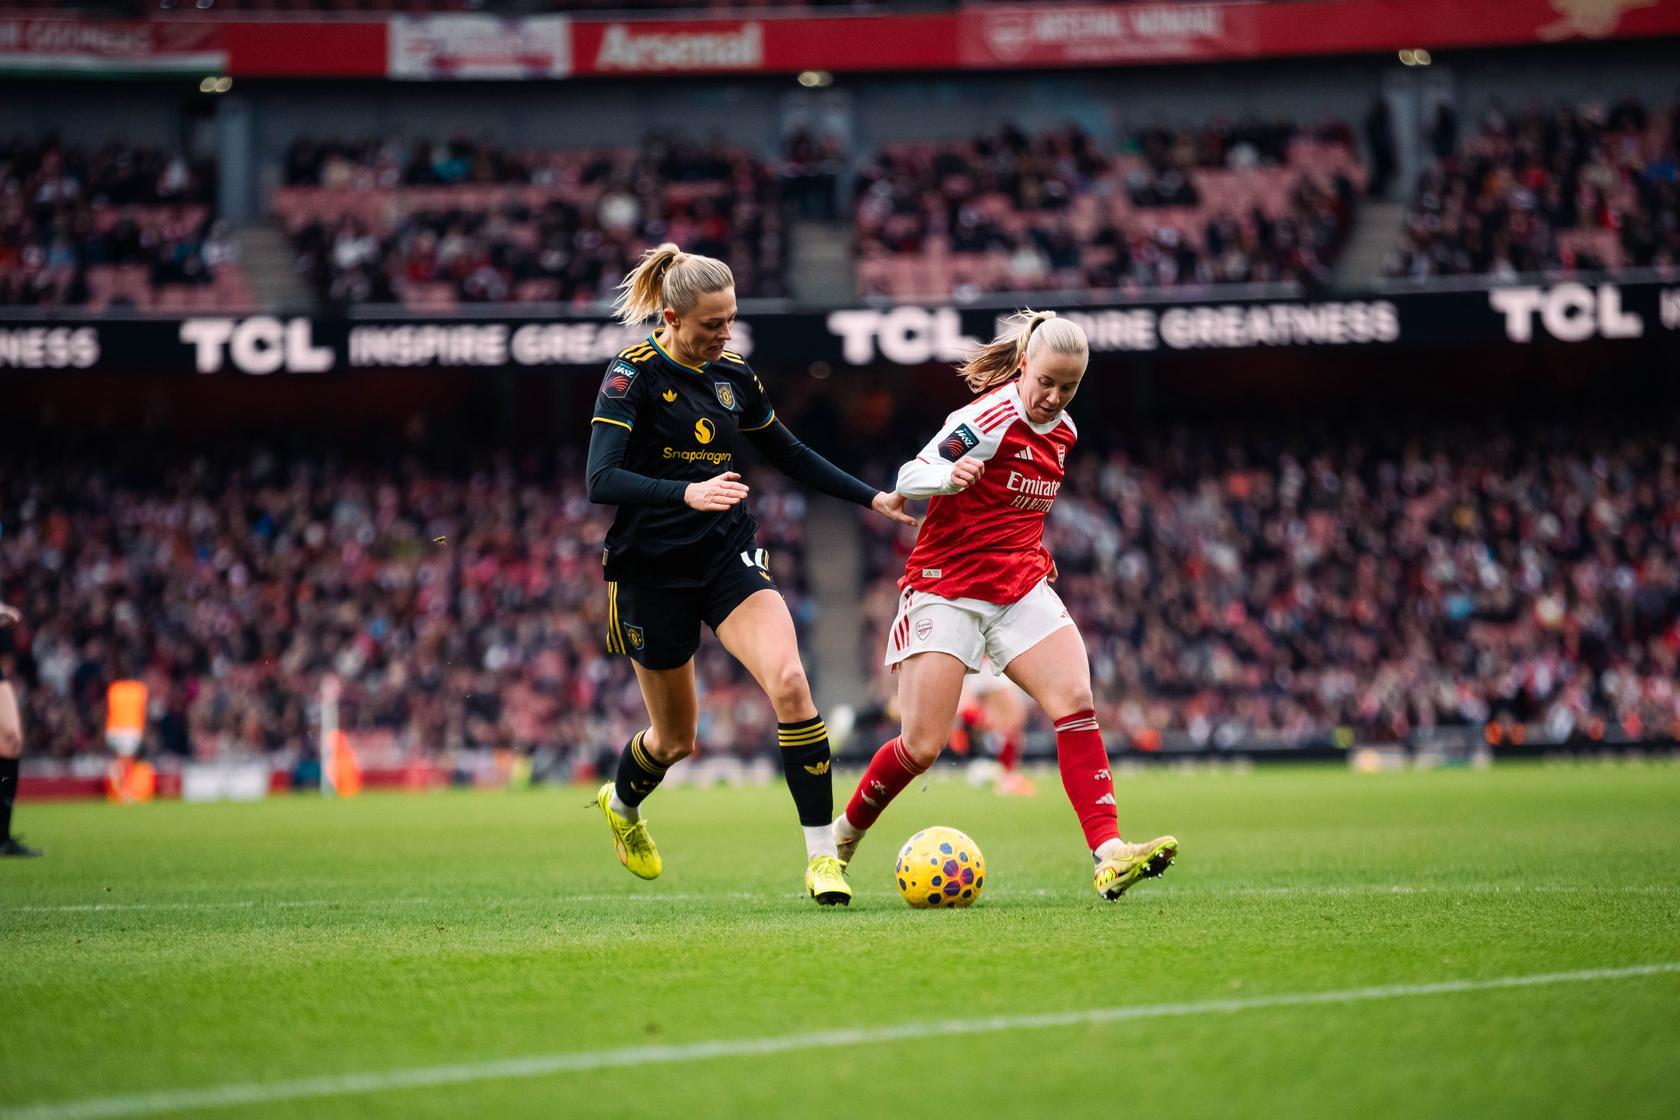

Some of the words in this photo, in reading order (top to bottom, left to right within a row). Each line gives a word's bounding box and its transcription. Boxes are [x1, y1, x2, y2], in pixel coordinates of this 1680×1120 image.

[596, 22, 764, 71] Arsenal
[179, 317, 333, 375] TCL
[349, 324, 507, 366] INSPIRE
[827, 306, 976, 364] TCL
[1160, 299, 1399, 350] GREATNESS
[1488, 282, 1644, 342] TCL
[1006, 470, 1062, 497] Emirate
